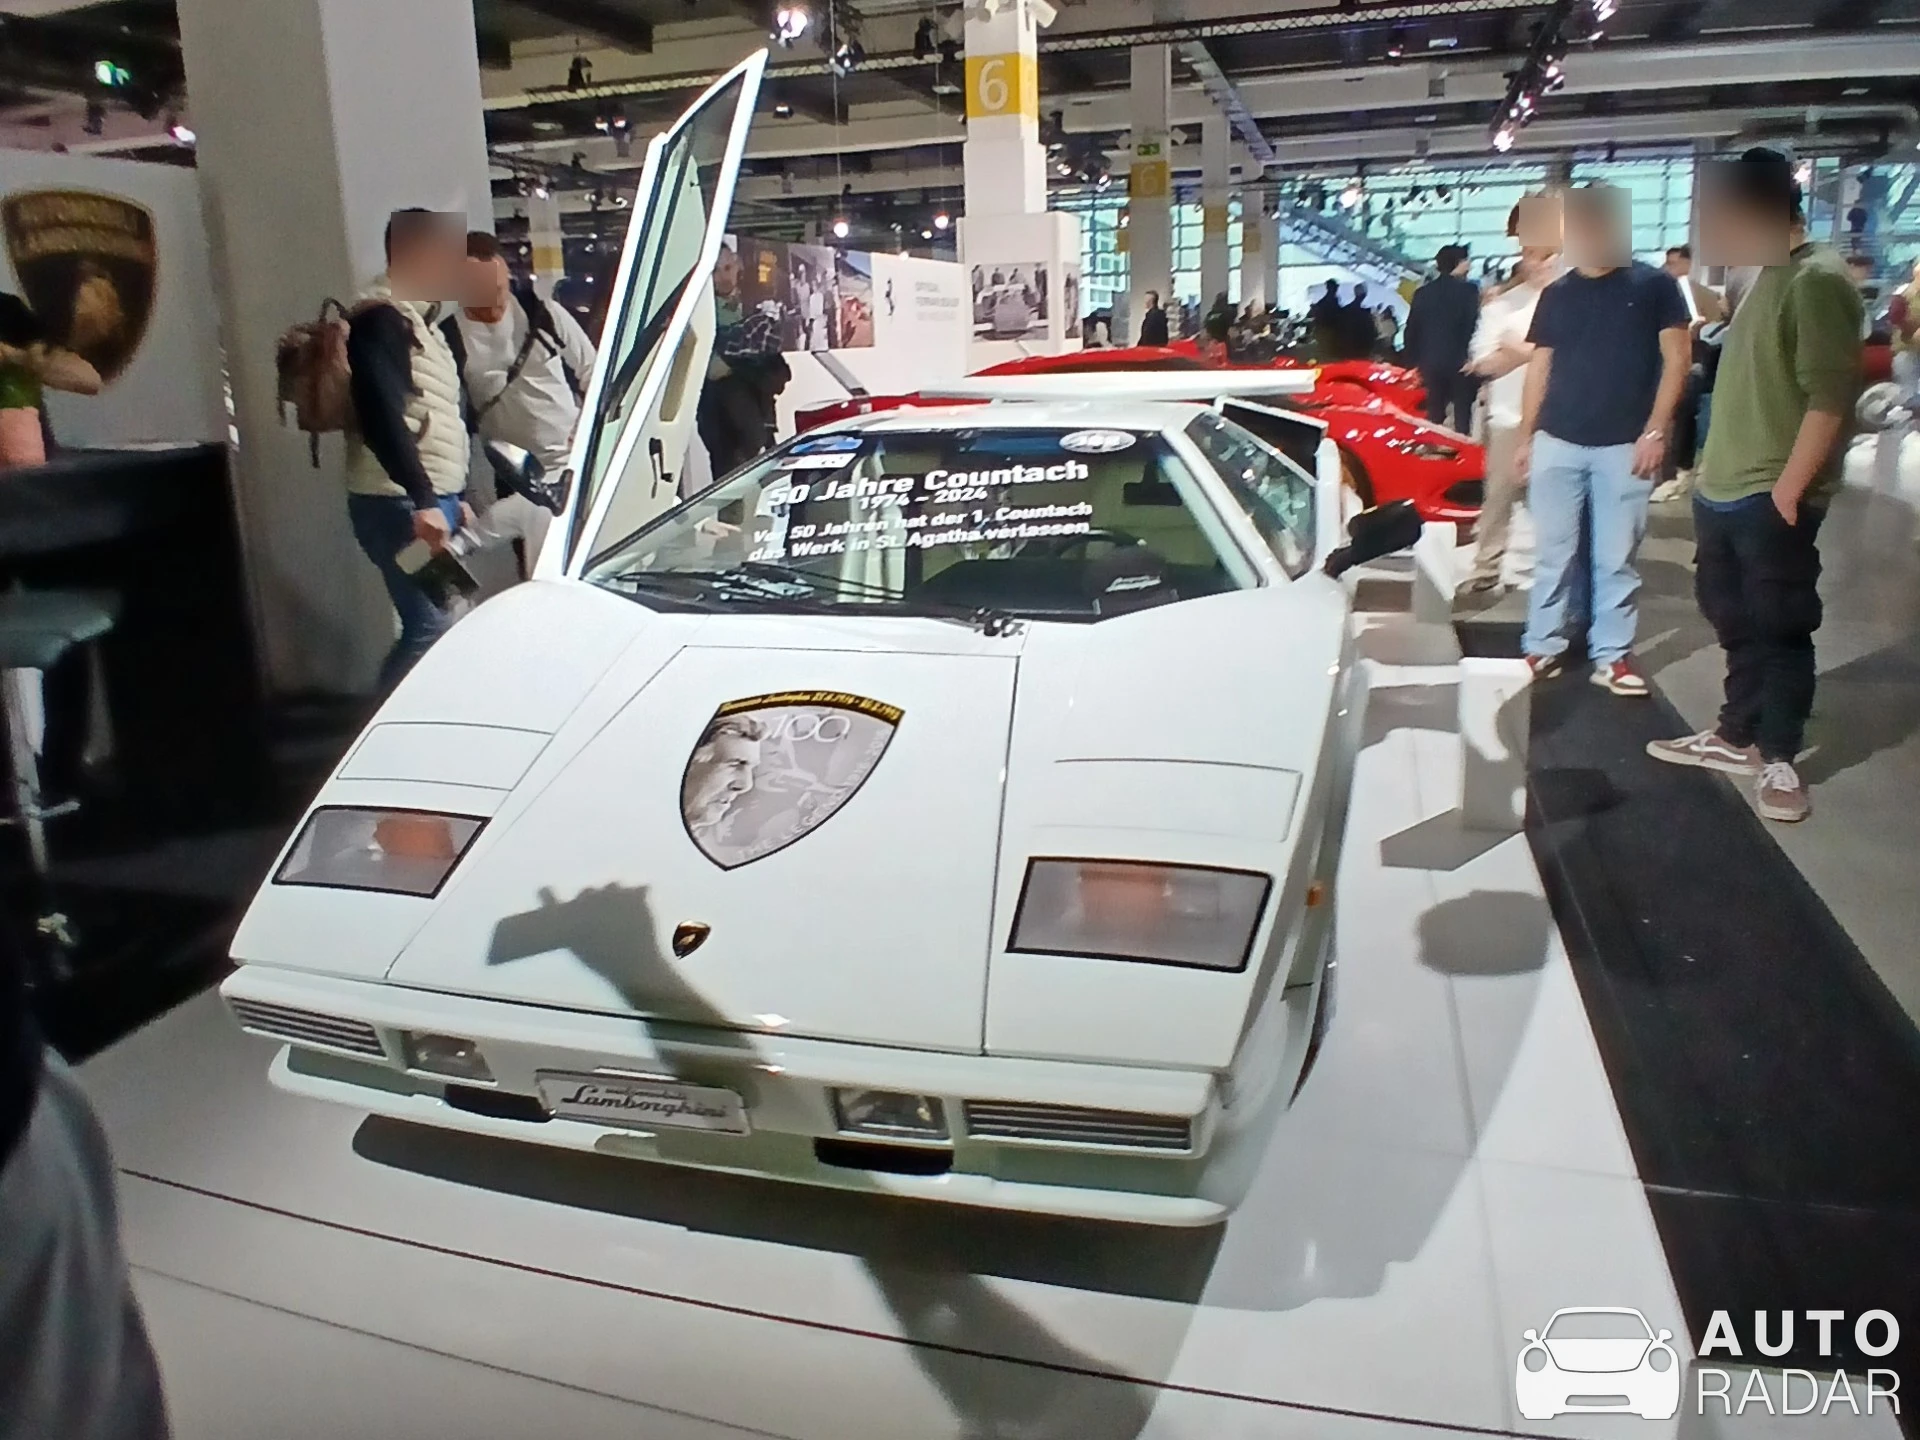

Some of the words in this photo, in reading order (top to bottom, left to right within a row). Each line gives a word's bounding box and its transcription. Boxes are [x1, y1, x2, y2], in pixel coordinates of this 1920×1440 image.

[979, 60, 1008, 111] 6
[767, 484, 811, 506] 50
[814, 477, 914, 501] Jahre
[924, 460, 1088, 490] Countach
[859, 494, 910, 510] 1974
[934, 487, 988, 503] 2024
[789, 525, 816, 540] 50
[818, 520, 889, 537] Jahren
[894, 514, 928, 529] hat
[930, 512, 968, 526] der
[995, 502, 1092, 521] Countach
[747, 547, 787, 562] das
[791, 539, 845, 557] Werk
[850, 537, 870, 552] in
[985, 521, 1090, 540] verlassen
[771, 713, 851, 742] 100
[561, 1084, 728, 1117] Lamborghini
